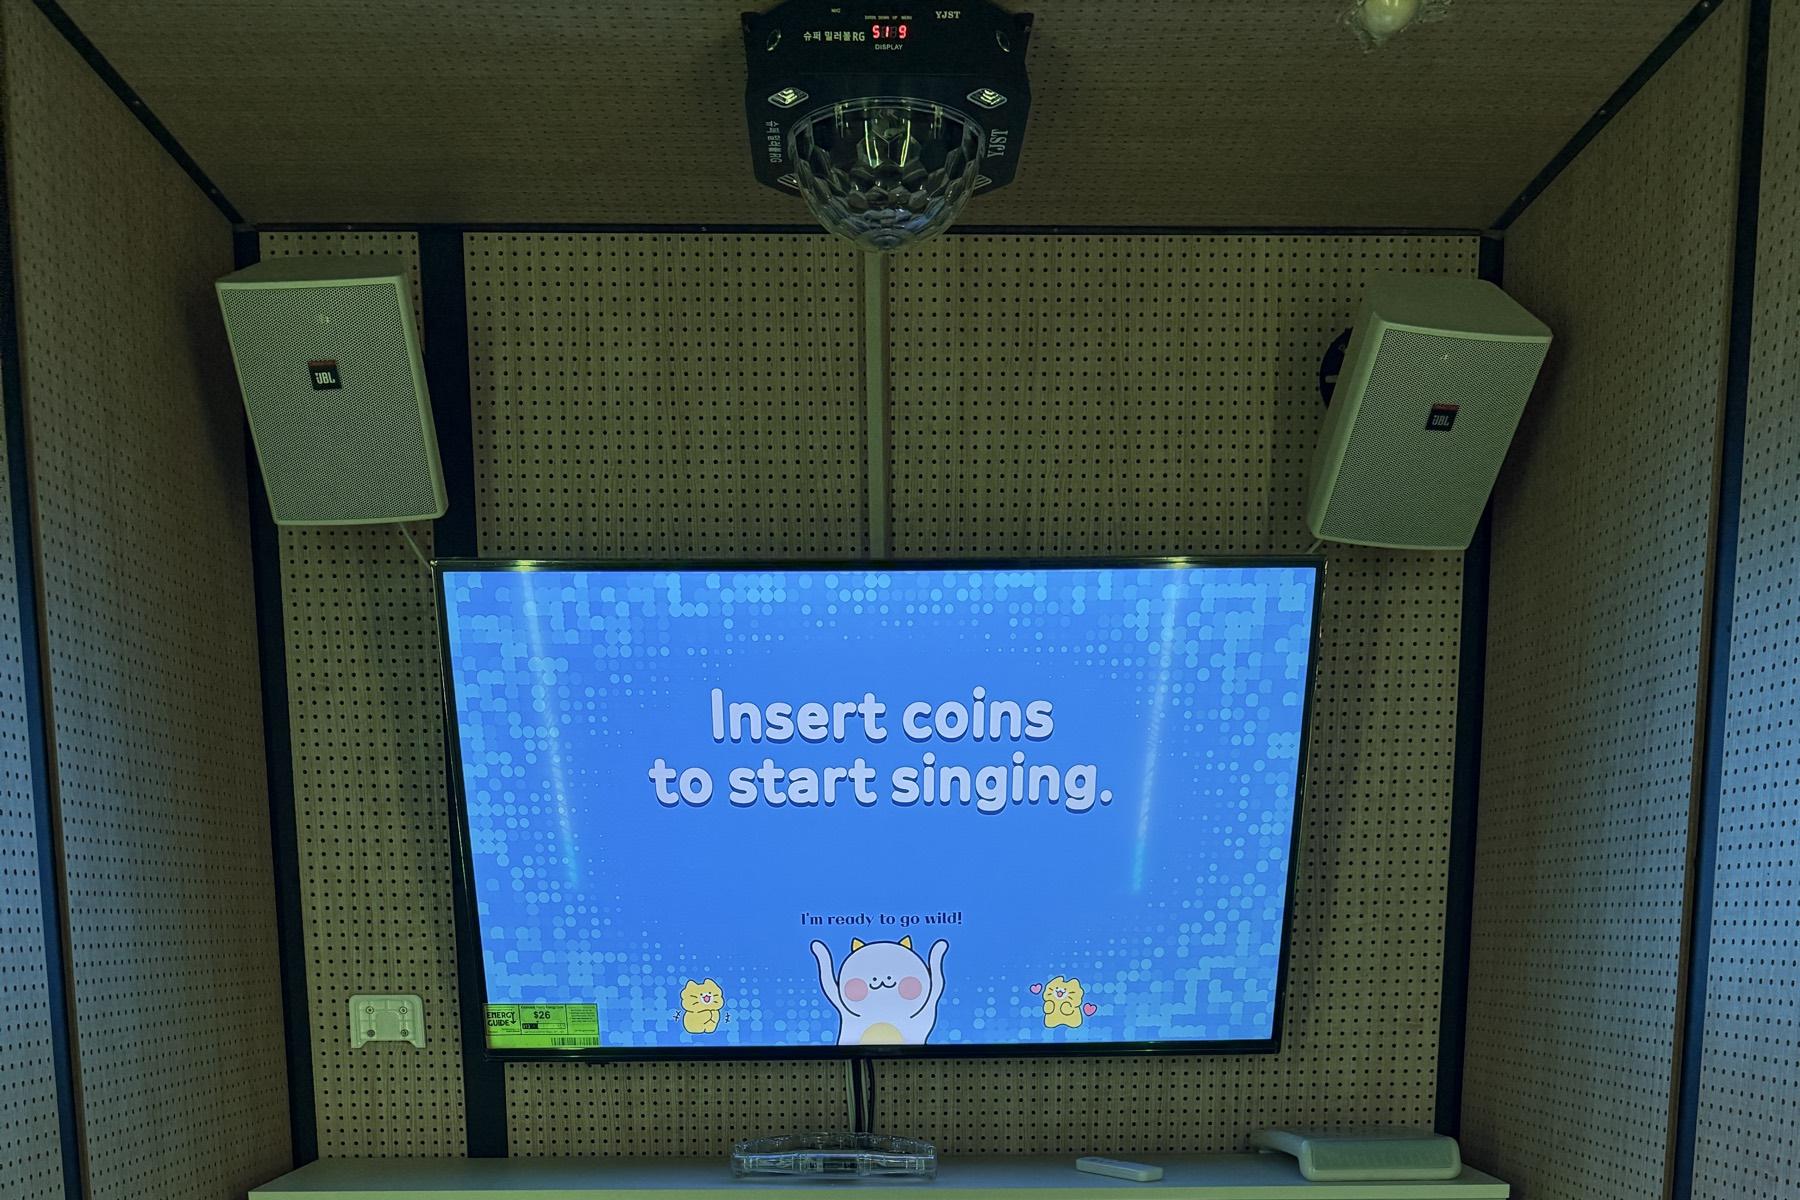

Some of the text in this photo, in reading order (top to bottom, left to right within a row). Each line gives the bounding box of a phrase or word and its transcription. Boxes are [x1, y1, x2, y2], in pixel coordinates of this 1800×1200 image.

[935, 11, 961, 19] YJST
[987, 128, 1009, 158] YJST
[314, 371, 336, 385] JBL
[711, 685, 1055, 743] Insert coins
[648, 750, 1114, 815] to start singing.
[801, 911, 962, 928] I'm ready to go wild!
[487, 1011, 515, 1019] ENERGY
[533, 1010, 551, 1020] $26
